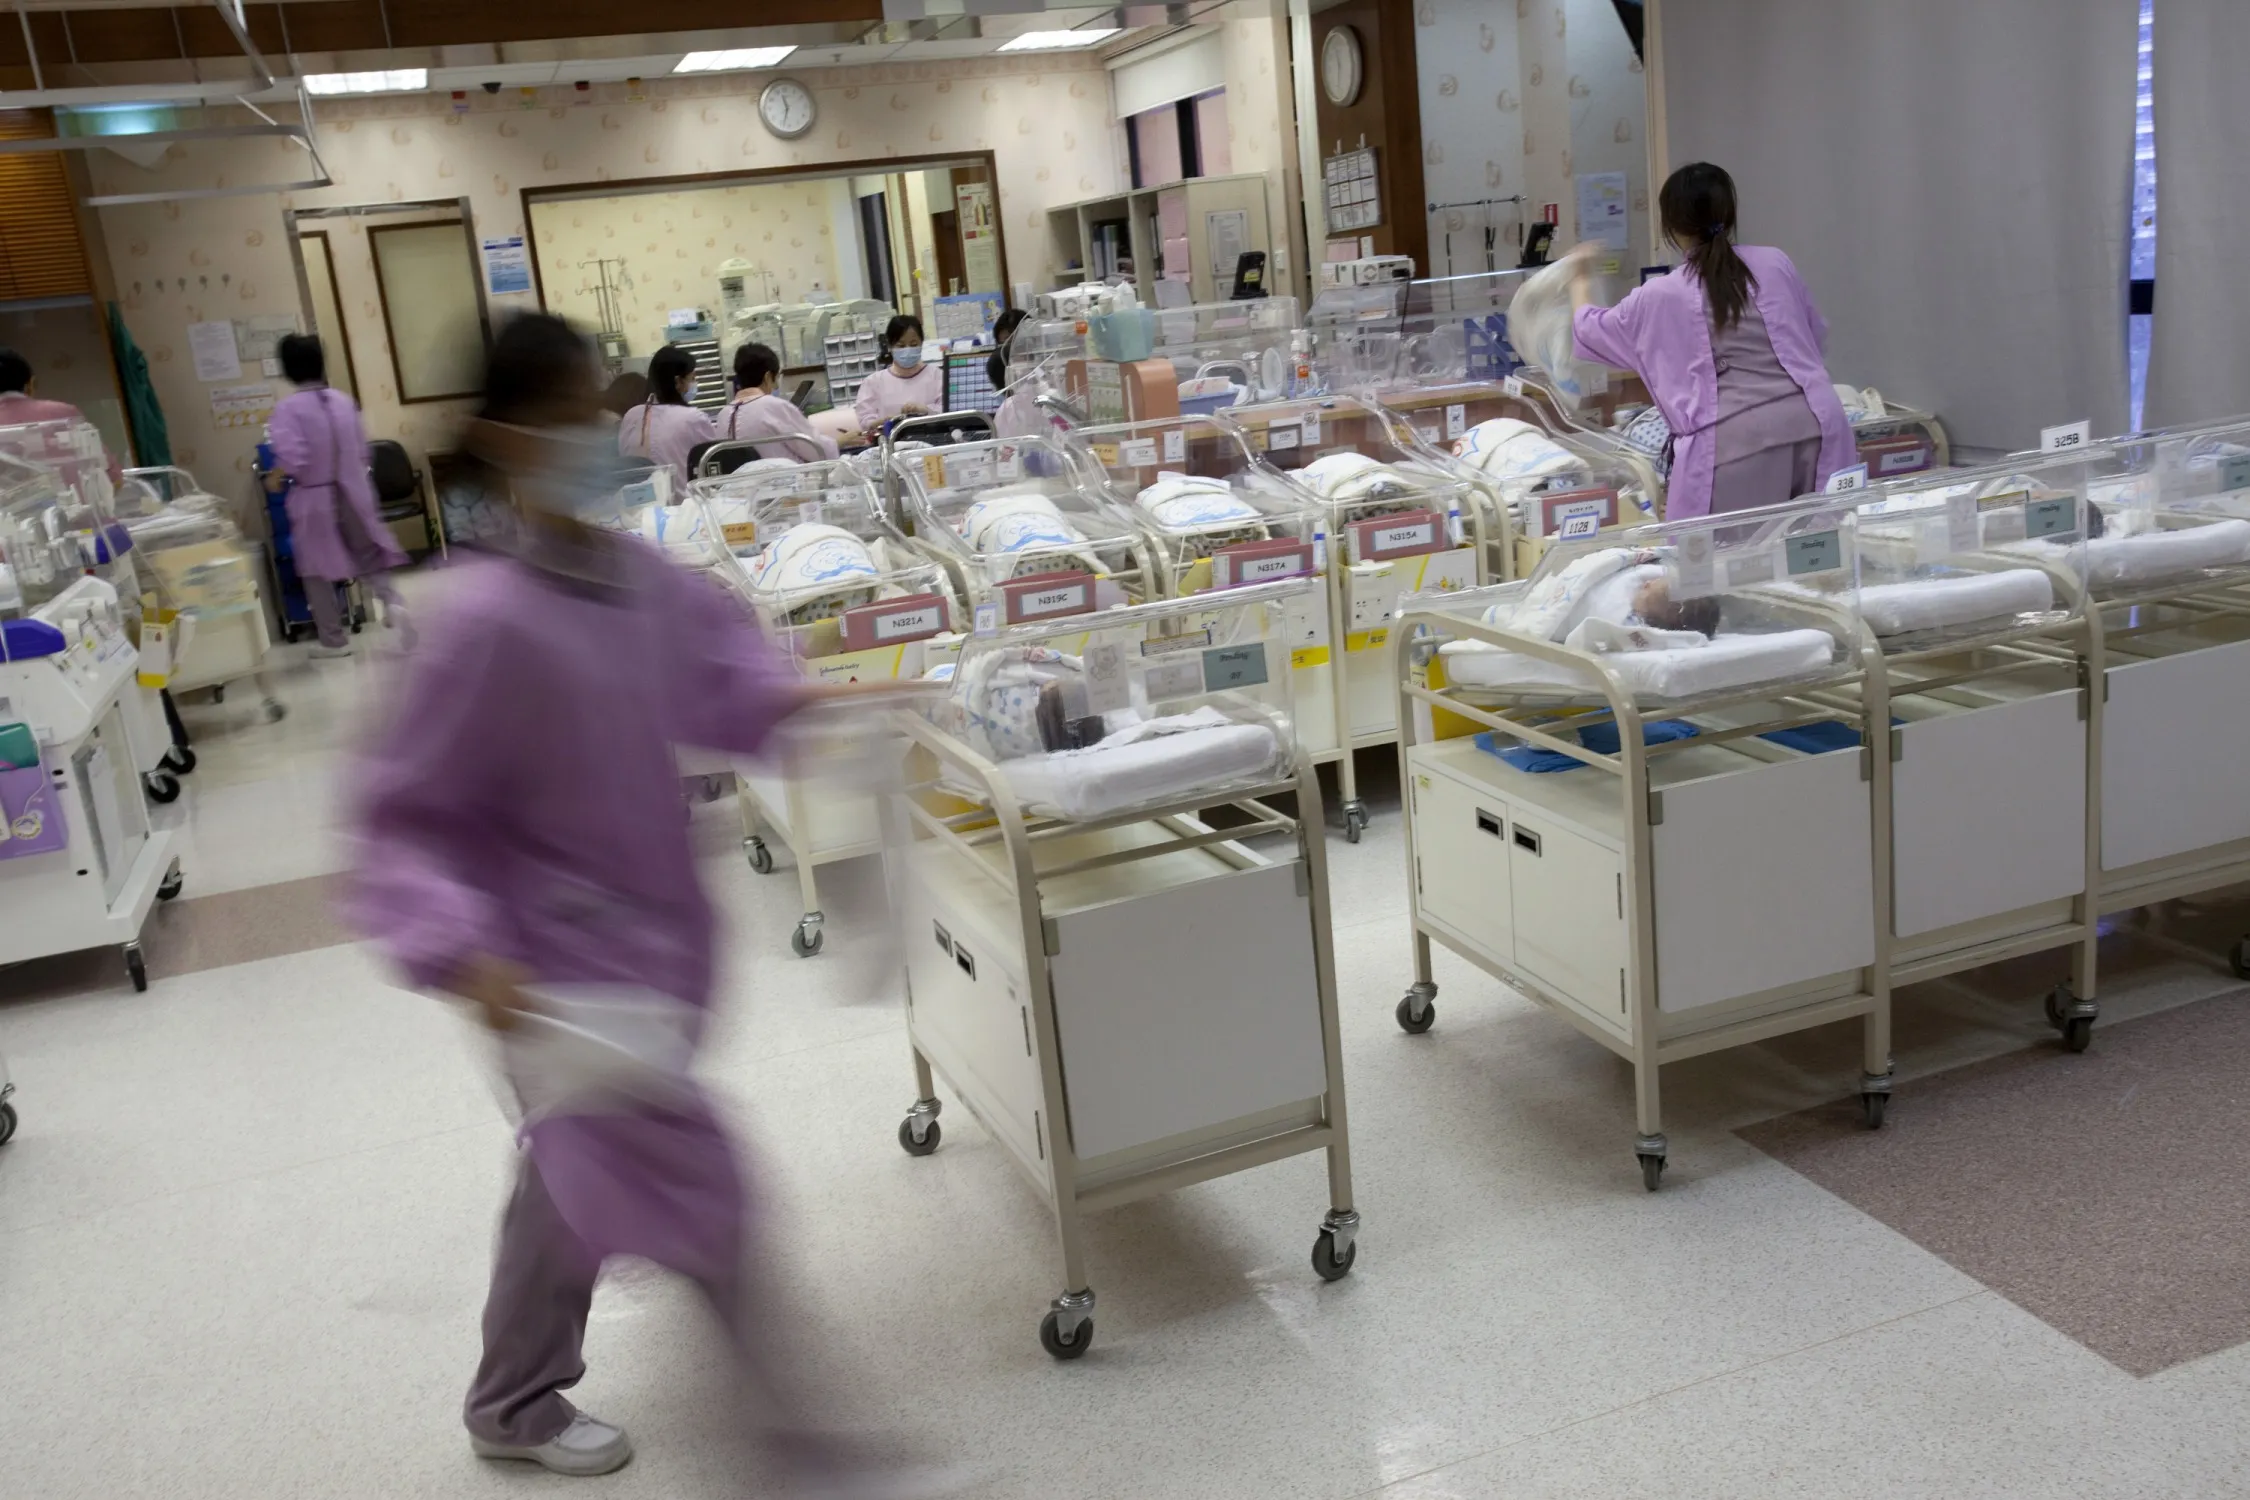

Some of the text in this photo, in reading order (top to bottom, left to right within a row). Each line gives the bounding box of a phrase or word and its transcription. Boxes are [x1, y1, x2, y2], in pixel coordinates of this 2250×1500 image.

[1388, 530, 1418, 542] N315A
[1257, 561, 1287, 573] N317A
[1038, 593, 1068, 606] N319C
[892, 615, 924, 629] N321A
